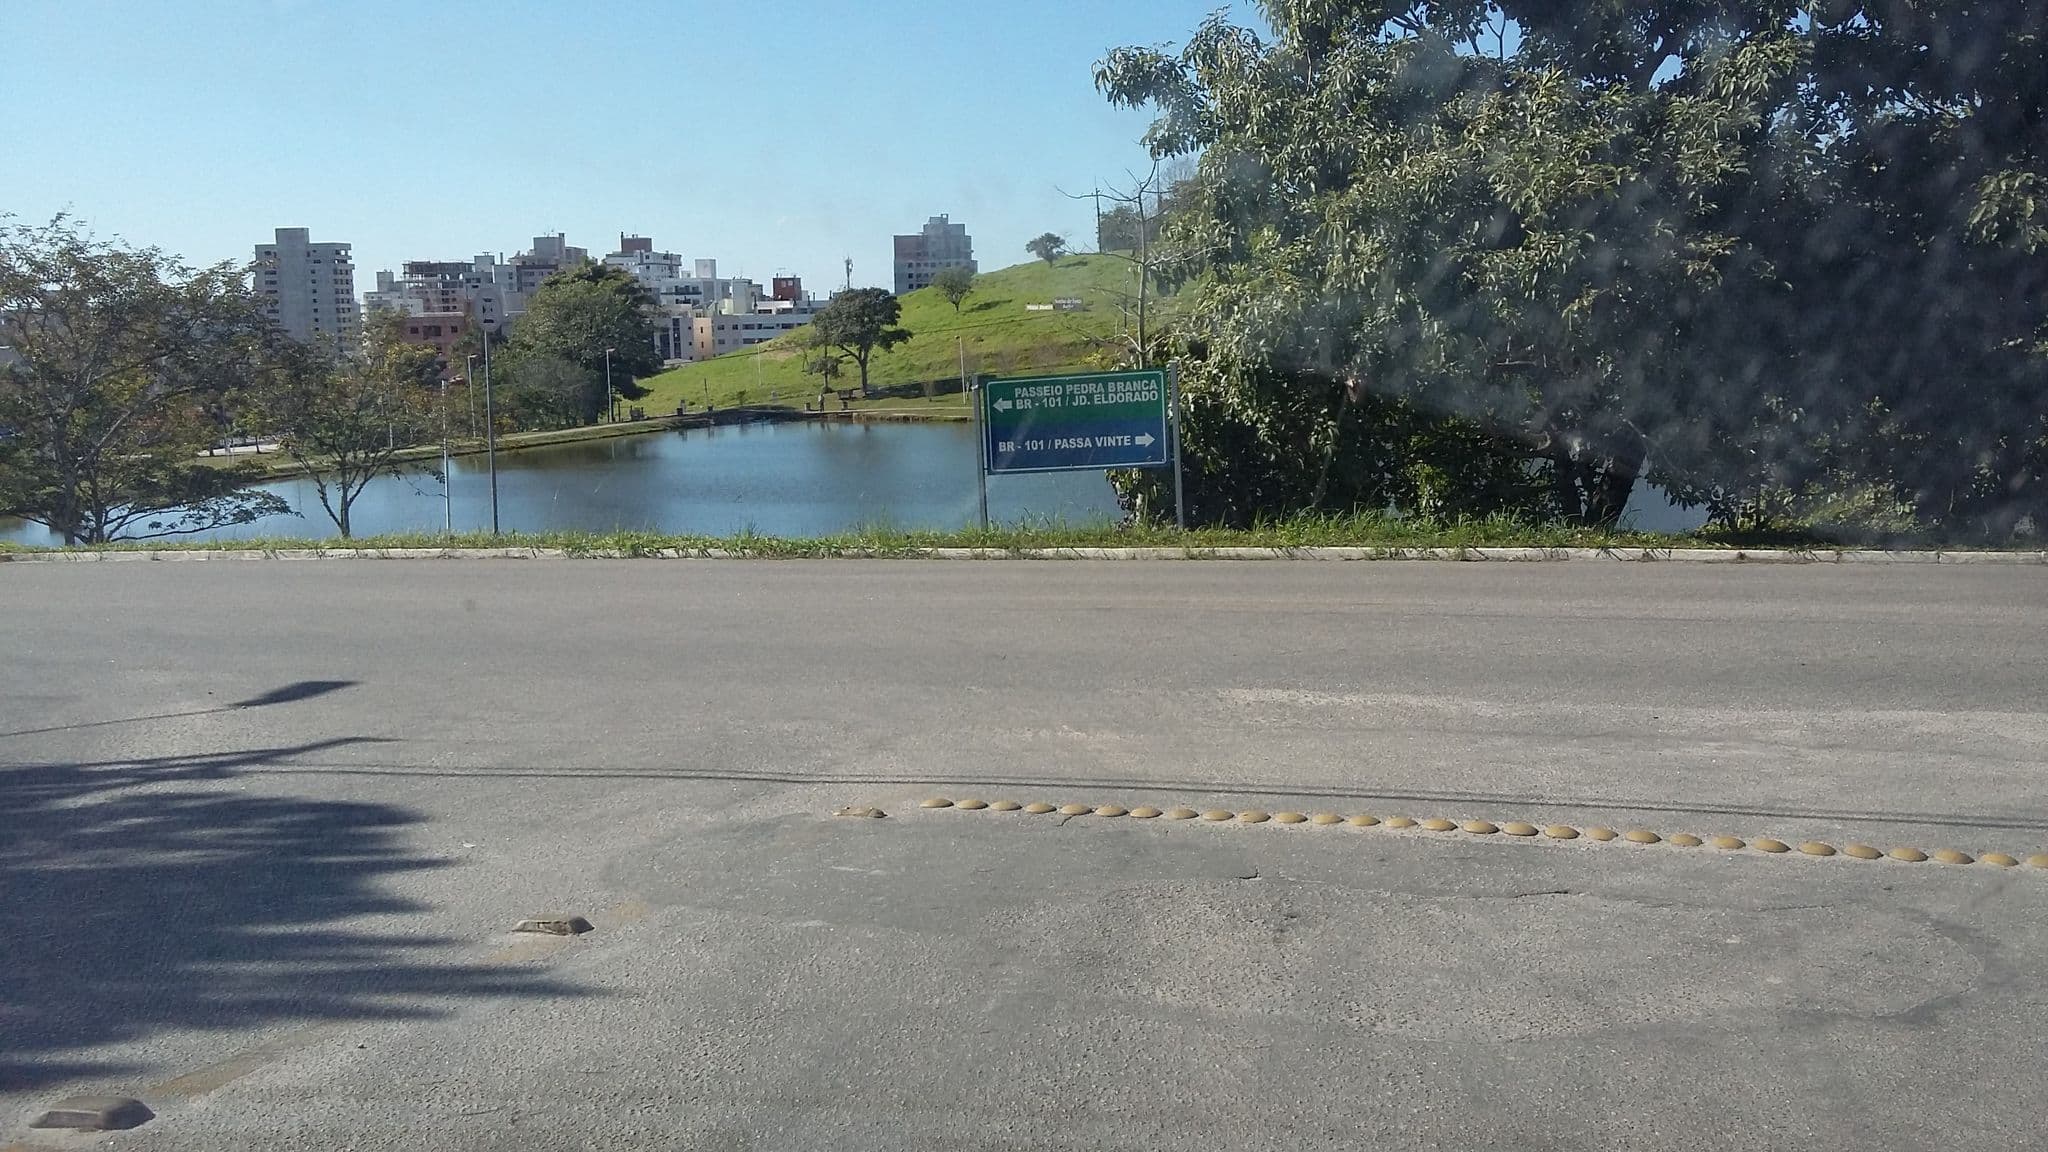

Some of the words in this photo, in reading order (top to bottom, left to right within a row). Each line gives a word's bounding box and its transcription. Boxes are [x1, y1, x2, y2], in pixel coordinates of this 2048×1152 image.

[1015, 386, 1062, 398] PASSEIO
[1066, 383, 1104, 395] PEDRA
[1108, 380, 1158, 392] BRANCA
[1016, 400, 1031, 409] BR
[1042, 397, 1062, 408] 101
[1072, 396, 1090, 406] JD.
[1094, 391, 1158, 404] ELDORADO
[999, 441, 1014, 452] BR
[1027, 440, 1044, 450] 101
[1055, 438, 1092, 449] PASSA
[1095, 436, 1130, 447] VINTE
